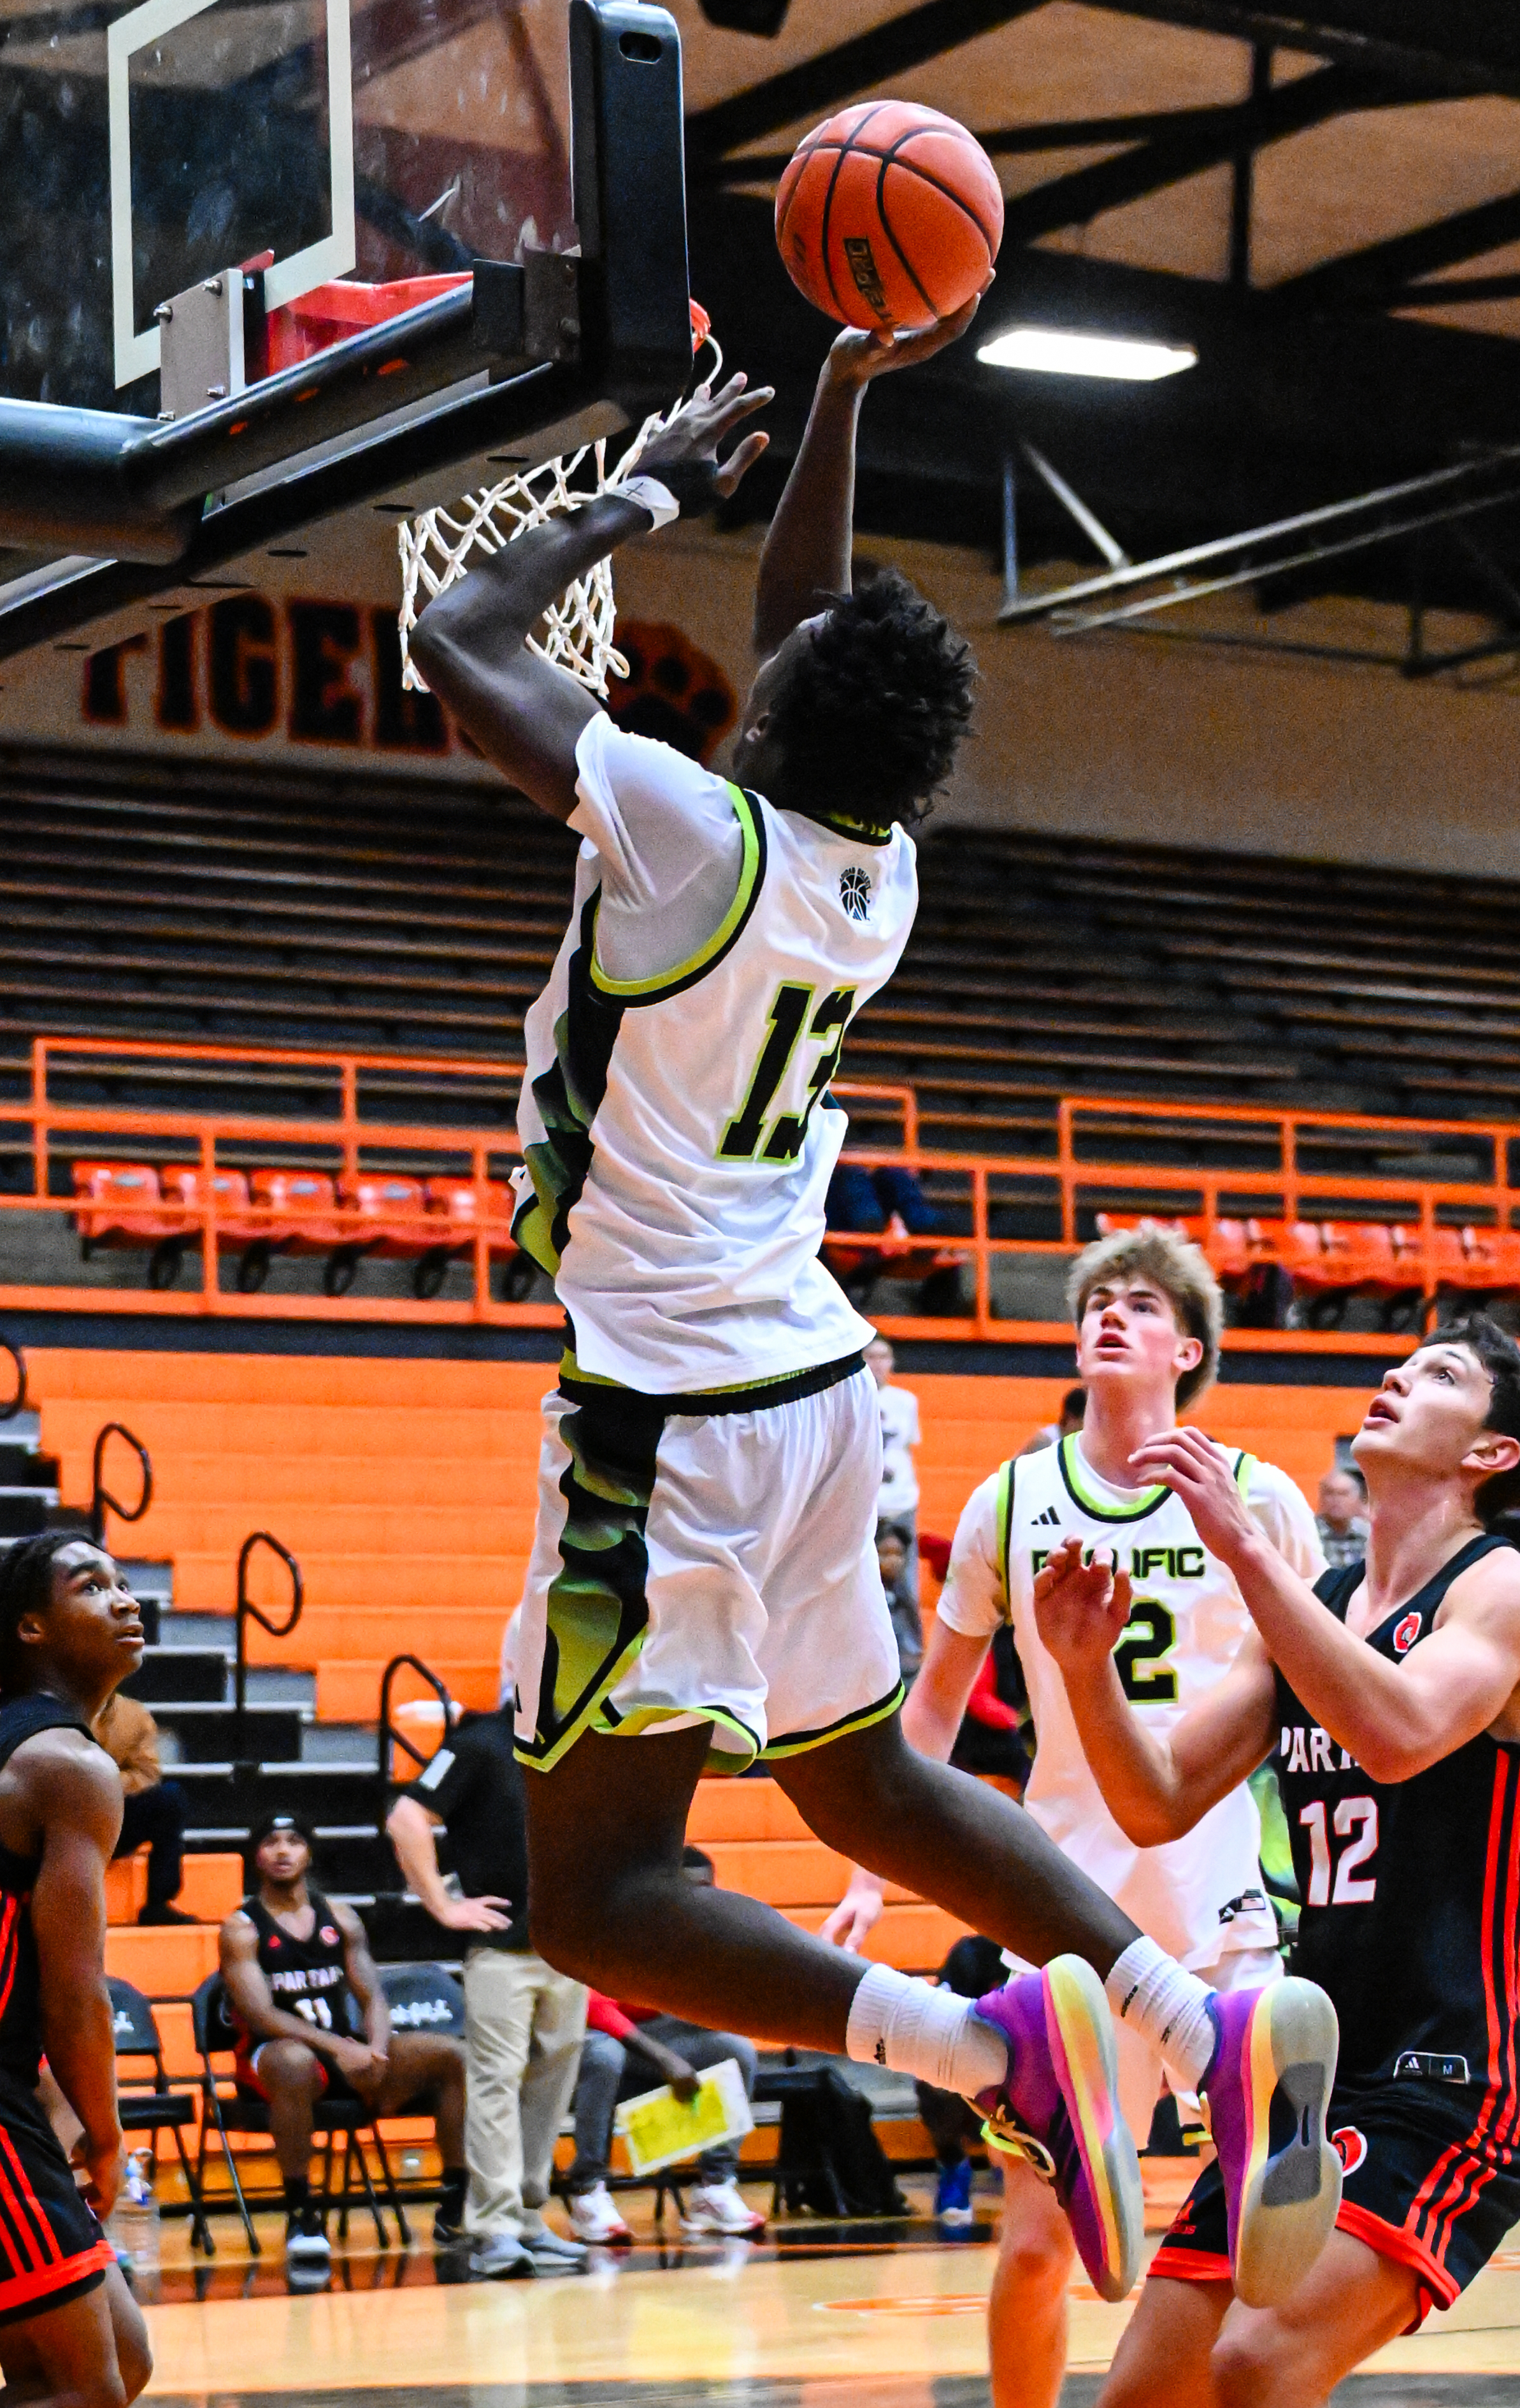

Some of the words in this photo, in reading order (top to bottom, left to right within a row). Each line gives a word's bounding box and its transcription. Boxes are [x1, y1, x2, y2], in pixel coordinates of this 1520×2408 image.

[1112, 1596, 1179, 1705] 2
[1298, 1794, 1380, 1908] 12
[1443, 2064, 1453, 2075] M
